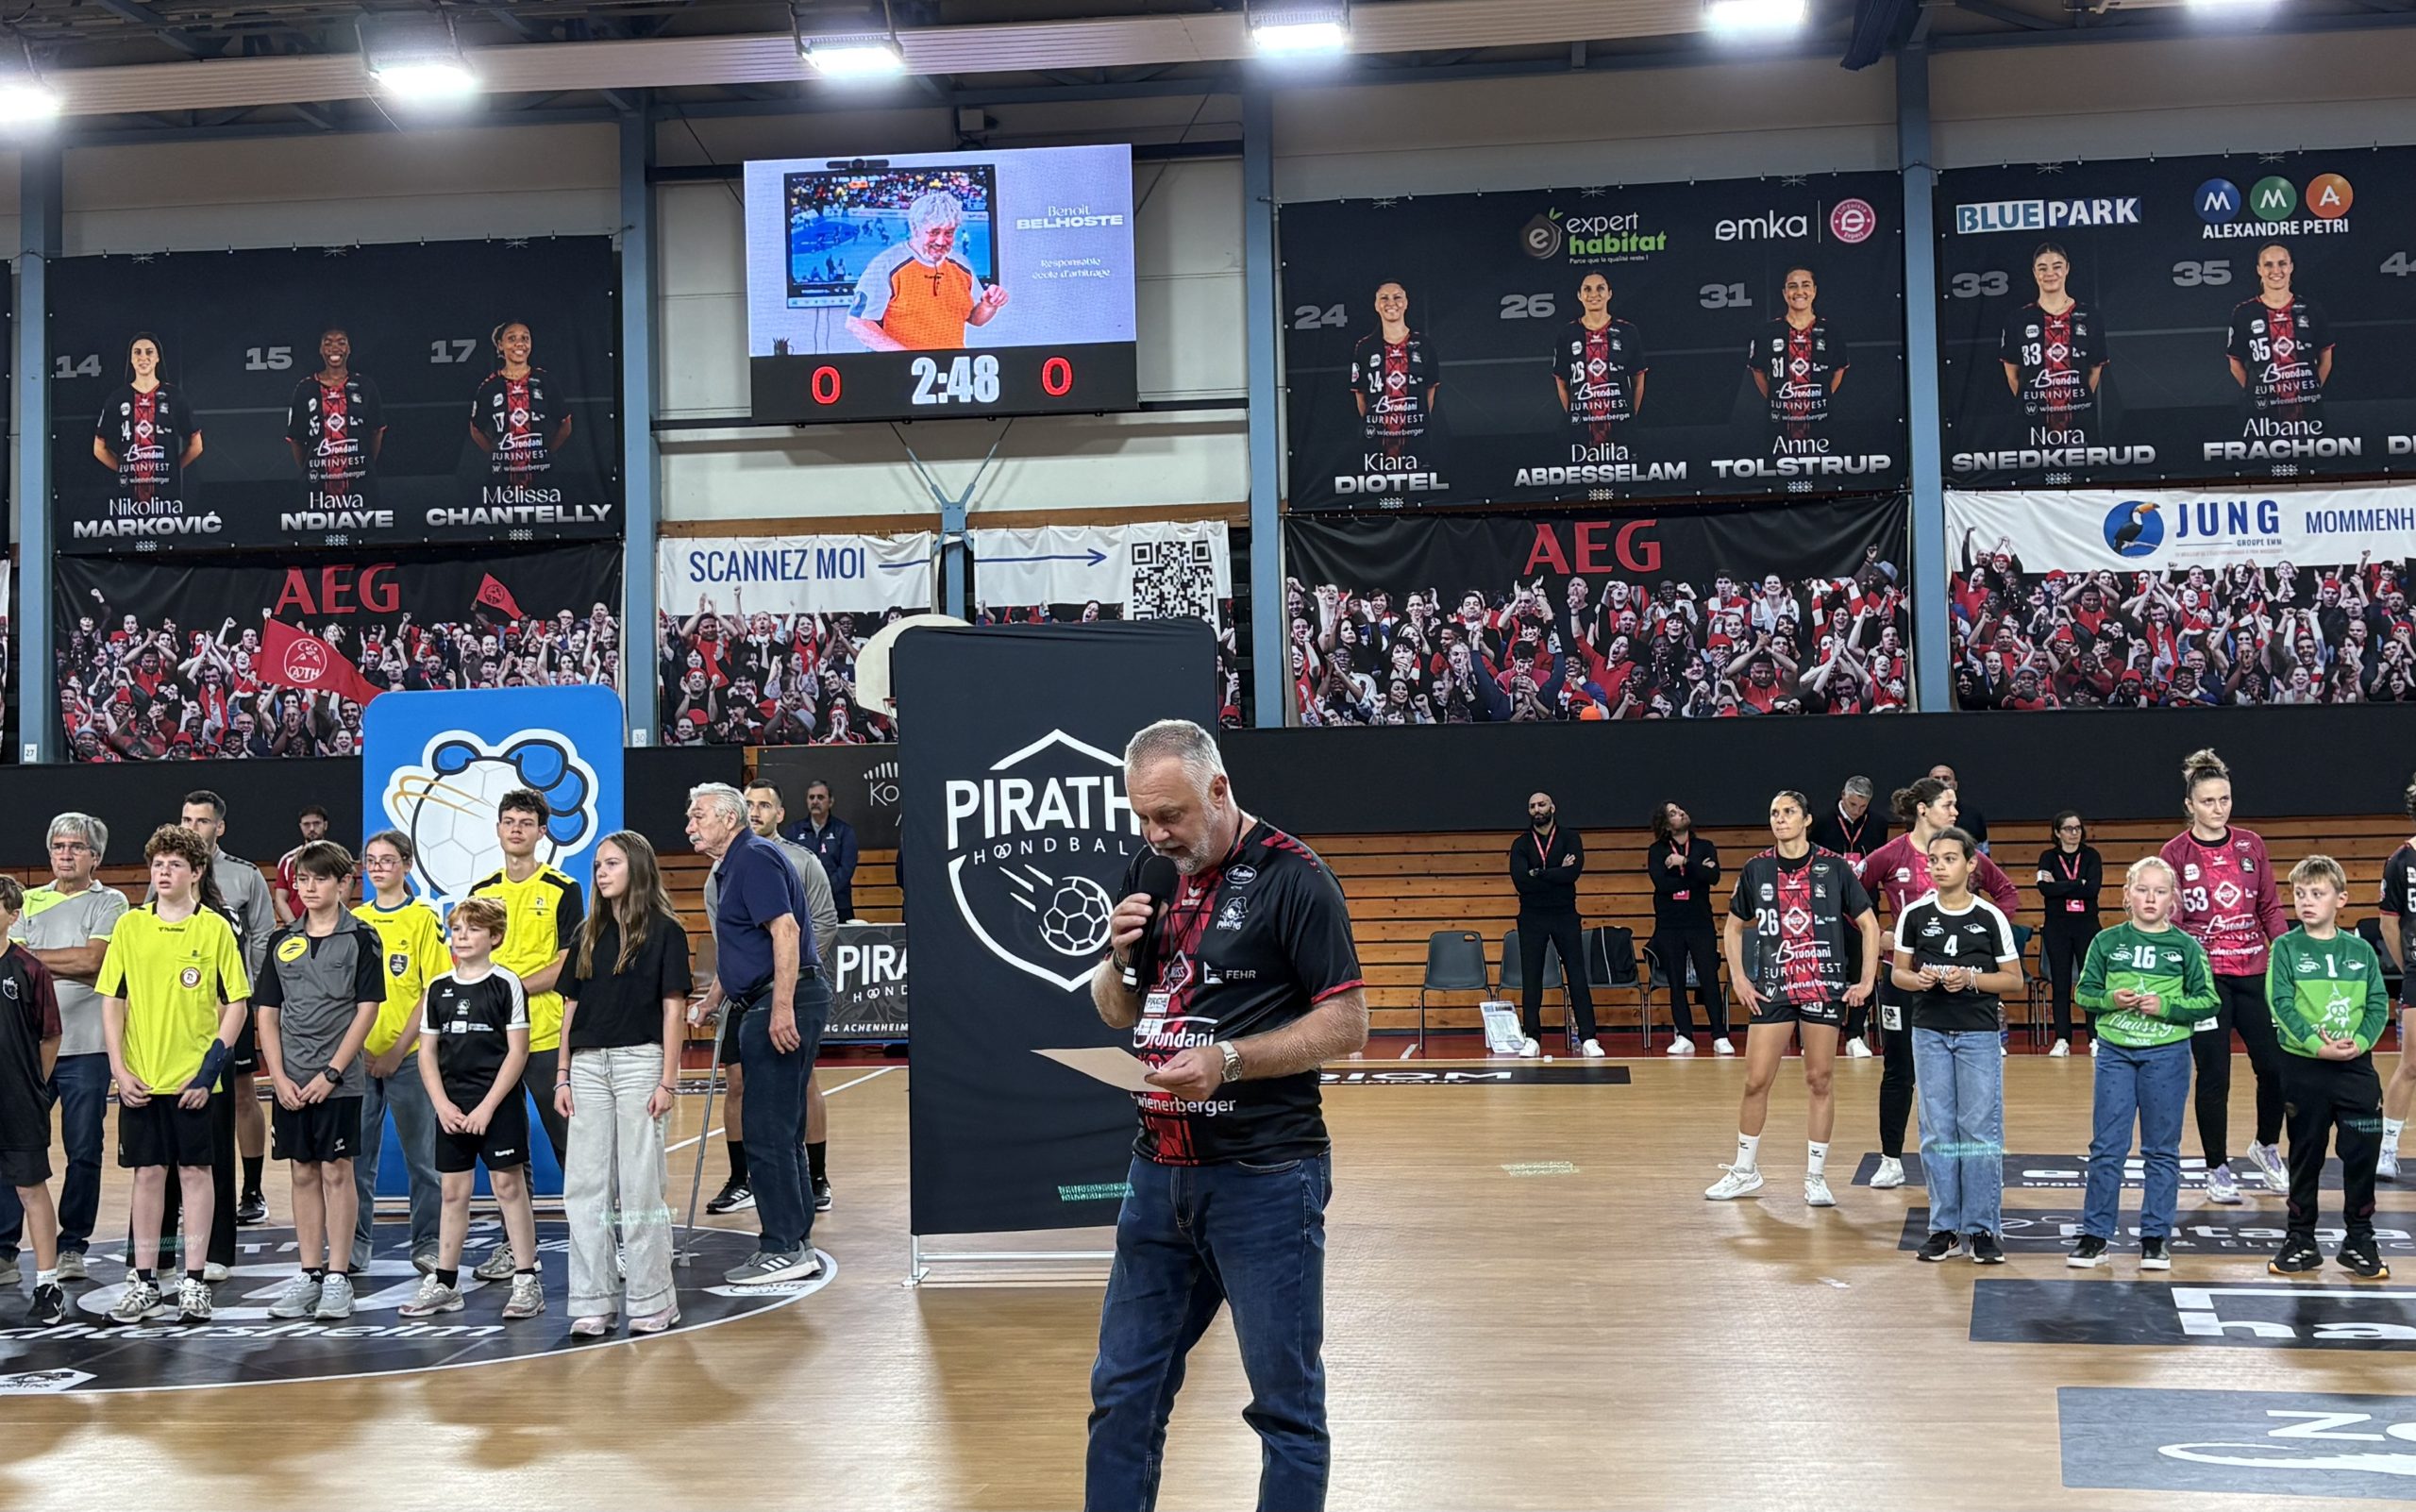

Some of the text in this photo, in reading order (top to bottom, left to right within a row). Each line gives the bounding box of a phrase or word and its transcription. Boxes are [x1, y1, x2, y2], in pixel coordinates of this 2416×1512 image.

[2204, 185, 2341, 211] M M A
[1016, 215, 1123, 229] BELHOSTE
[1567, 211, 1639, 235] expert
[1715, 210, 1808, 242] emka
[2202, 219, 2350, 240] ALEXANDRE PETRI
[1569, 230, 1667, 257] habitat
[1041, 258, 1101, 268] Responsable
[2173, 260, 2232, 287] 35
[1699, 282, 1753, 309] 31
[1952, 271, 2009, 298] 33
[1294, 303, 1348, 329] 24
[1500, 294, 1555, 319] 26
[245, 346, 293, 371] 15
[430, 339, 477, 363] 17
[2022, 343, 2042, 366] 33
[2249, 337, 2272, 362] 35
[55, 354, 102, 378] 14
[1771, 357, 1784, 378] 31
[812, 355, 1073, 405] 0 2:48 0
[1367, 371, 1384, 394] 24
[2023, 388, 2086, 400] EURINVES
[2030, 426, 2085, 446] Nora
[2243, 417, 2324, 438] Albane
[1571, 443, 1629, 462] Dalila
[1772, 435, 1830, 455] Anne
[2204, 437, 2362, 462] FRACHON
[2388, 436, 2416, 455] D
[1364, 452, 1418, 472] Kiara
[1710, 454, 1891, 479] TOLSTRUP
[1952, 445, 2156, 473] SNEDKERUD
[1334, 472, 1450, 494] DIOTEL
[1514, 462, 1686, 487] ABDESSELAM
[109, 497, 183, 516] Nikolina
[310, 491, 363, 510] Hawa
[483, 485, 562, 504] Mélissa
[74, 511, 223, 538] MARKOVIĆ
[280, 510, 394, 531] N'DIAYE
[426, 504, 612, 527] CHANTELLY
[2176, 499, 2279, 538] JUNG
[2306, 507, 2416, 534] MOMMENH
[1523, 519, 1662, 576] AEG
[690, 547, 864, 582] SCANNEZ MOI
[274, 563, 400, 615] AEG
[946, 776, 1141, 850] PIRATH
[973, 837, 1129, 865] HANDBAL
[2183, 886, 2209, 913] 53
[2408, 888, 2416, 913] 5
[1755, 908, 1779, 936] 26
[1771, 940, 1831, 964] Brondani
[1943, 934, 1958, 957] 4
[2131, 946, 2156, 969] 16
[836, 945, 908, 992] PIRA
[1226, 970, 1257, 980] FEHR
[2324, 953, 2339, 978] 1
[844, 1023, 908, 1033] ACHENHEIM
[1137, 1094, 1236, 1117] wienerberger
[2171, 1287, 2416, 1340] ha
